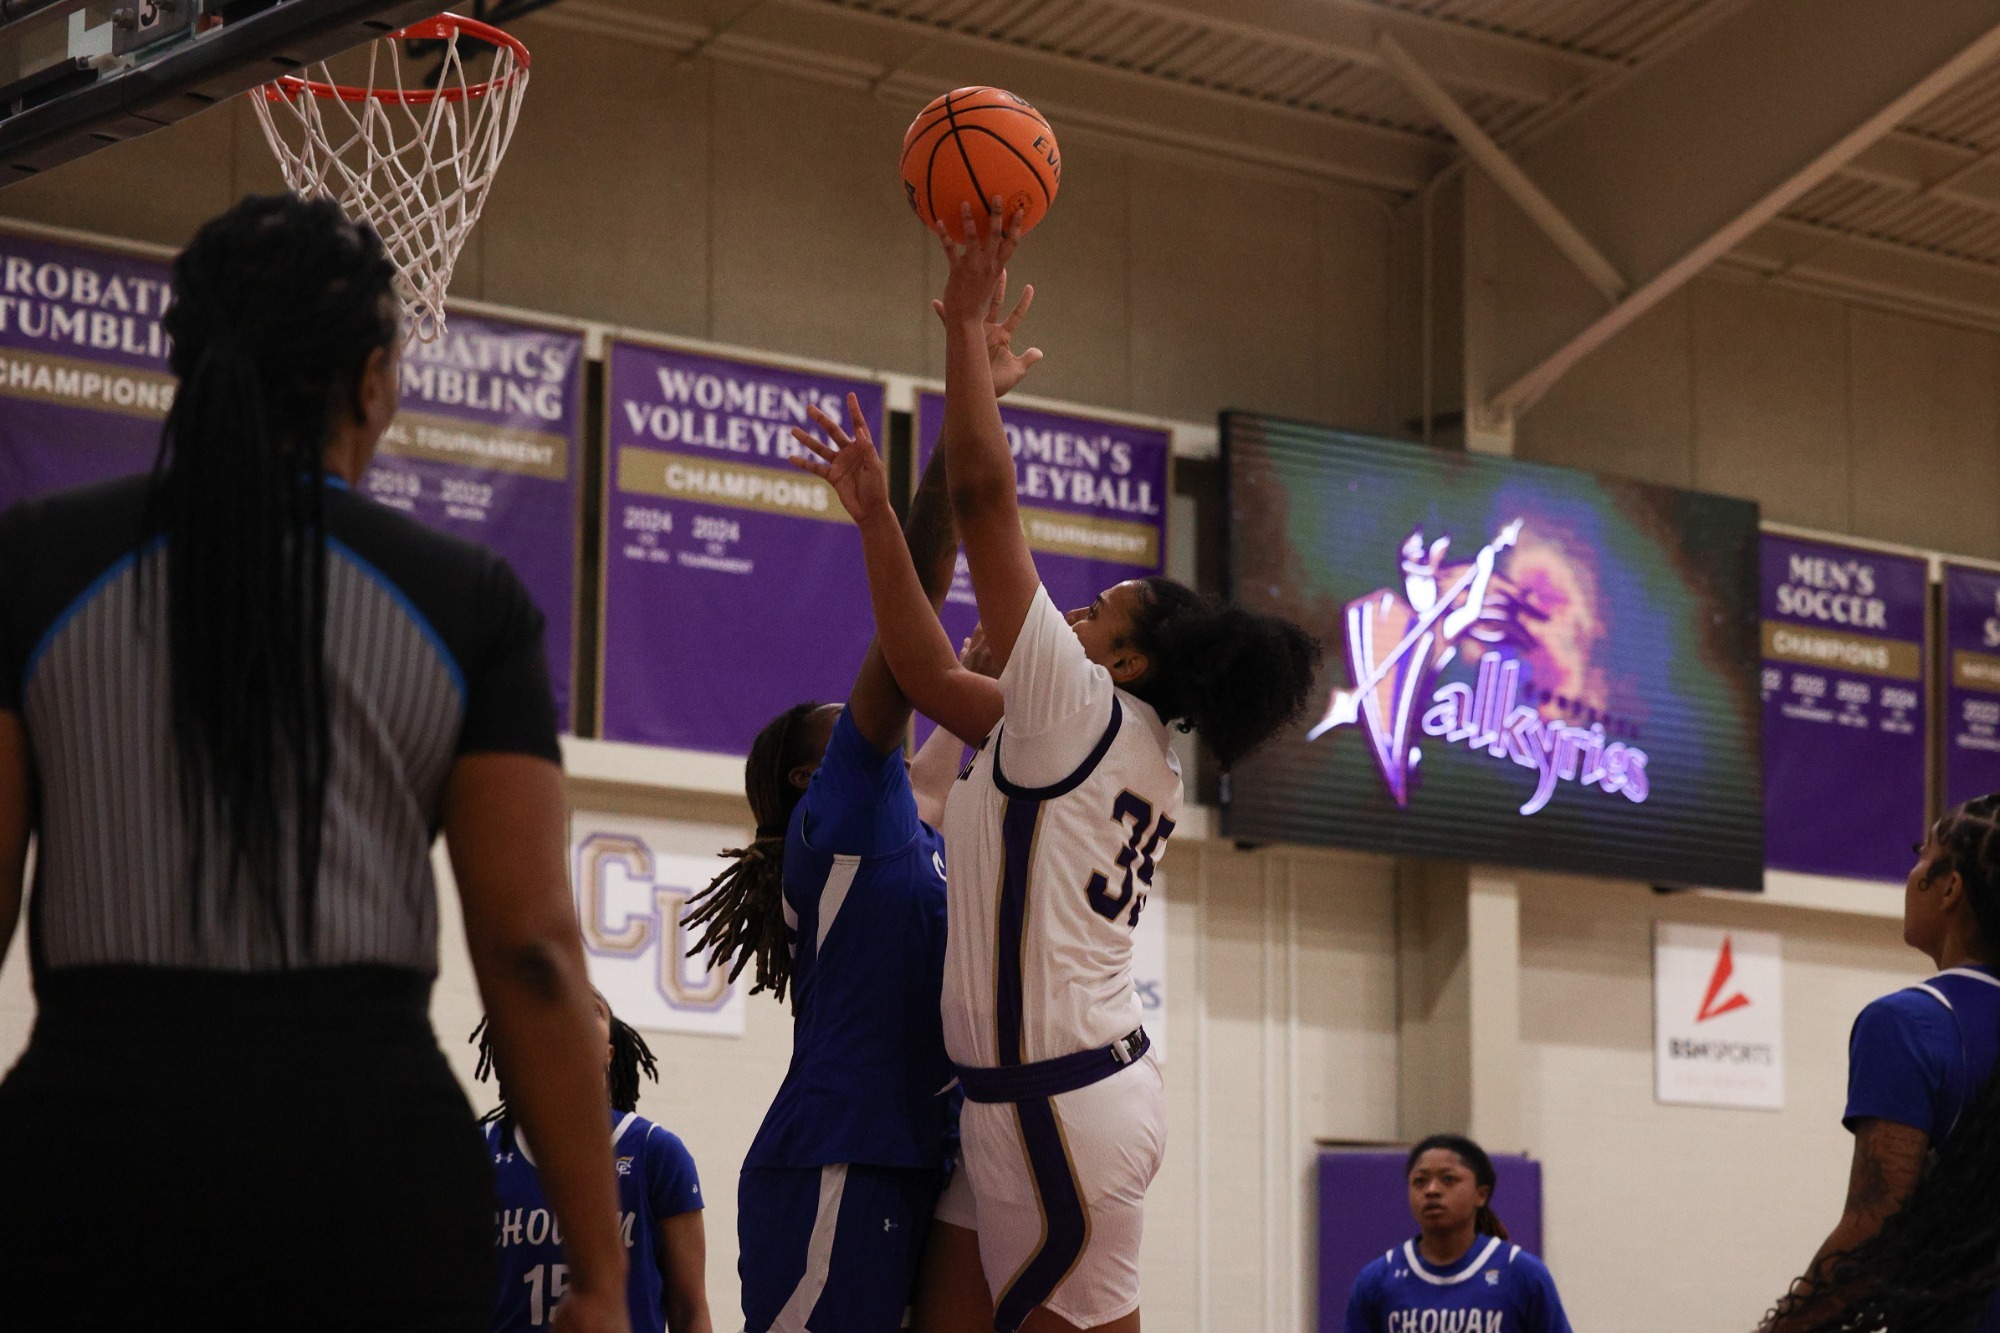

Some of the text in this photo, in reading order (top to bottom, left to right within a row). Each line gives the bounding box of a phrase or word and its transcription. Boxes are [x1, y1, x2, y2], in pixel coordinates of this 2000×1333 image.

[657, 366, 843, 426] WOMEN'S
[664, 463, 829, 513] CHAMPIONS
[623, 505, 741, 543] 2024 2024
[1789, 554, 1876, 597] MEN'S
[1777, 583, 1888, 630] SOCCER
[1773, 630, 1890, 671] CHAMPIONS
[1388, 1308, 1504, 1333] CHOWAN
